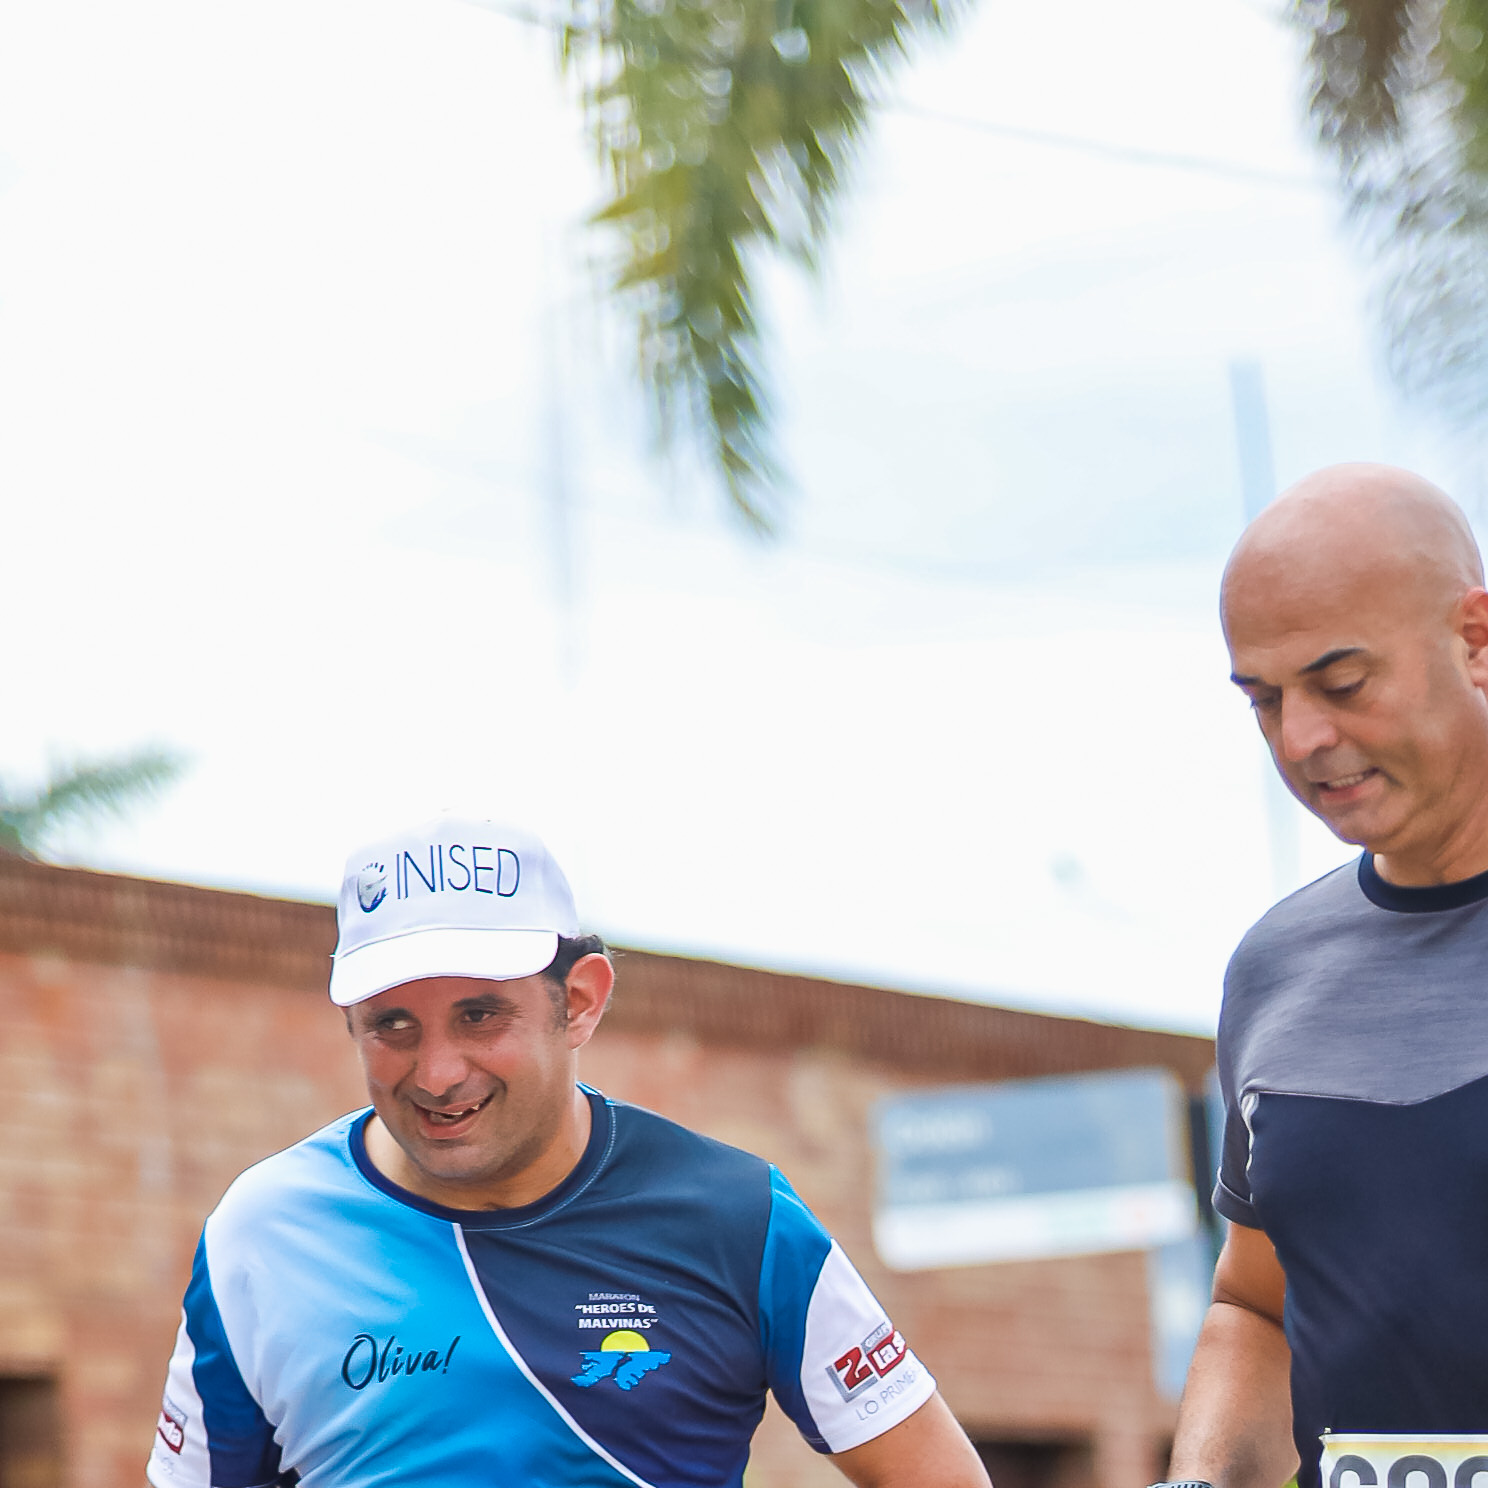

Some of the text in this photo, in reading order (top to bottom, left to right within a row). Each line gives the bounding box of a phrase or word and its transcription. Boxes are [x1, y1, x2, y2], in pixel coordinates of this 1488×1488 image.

[396, 844, 520, 899] INISED
[637, 1303, 657, 1314] DE
[342, 1333, 461, 1391] Oliva!
[855, 1400, 880, 1421] LO
